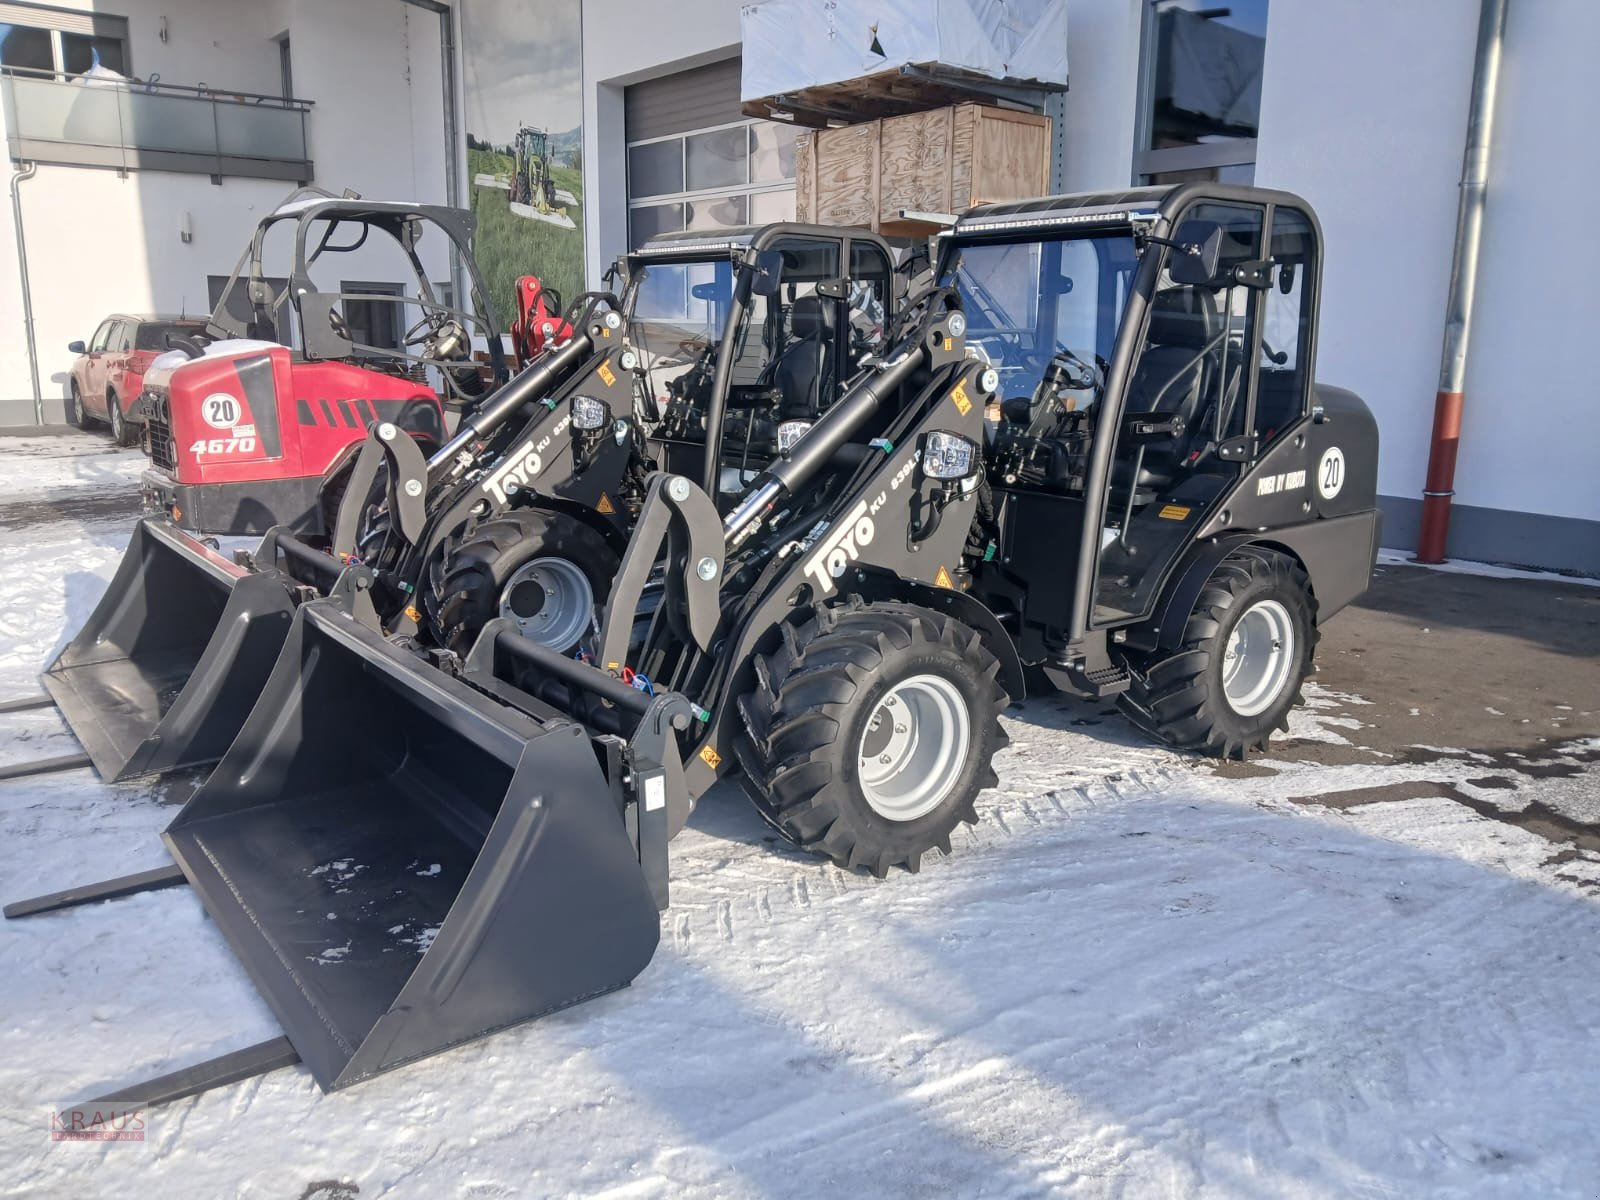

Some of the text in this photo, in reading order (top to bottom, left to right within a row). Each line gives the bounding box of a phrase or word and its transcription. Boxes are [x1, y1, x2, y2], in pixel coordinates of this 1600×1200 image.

[210, 400, 235, 422] 20
[189, 438, 256, 455] 4670
[482, 440, 541, 504] TOYO
[536, 436, 551, 453] KU
[1324, 457, 1340, 489] 20
[803, 499, 875, 593] TOYO
[870, 491, 887, 515] KU
